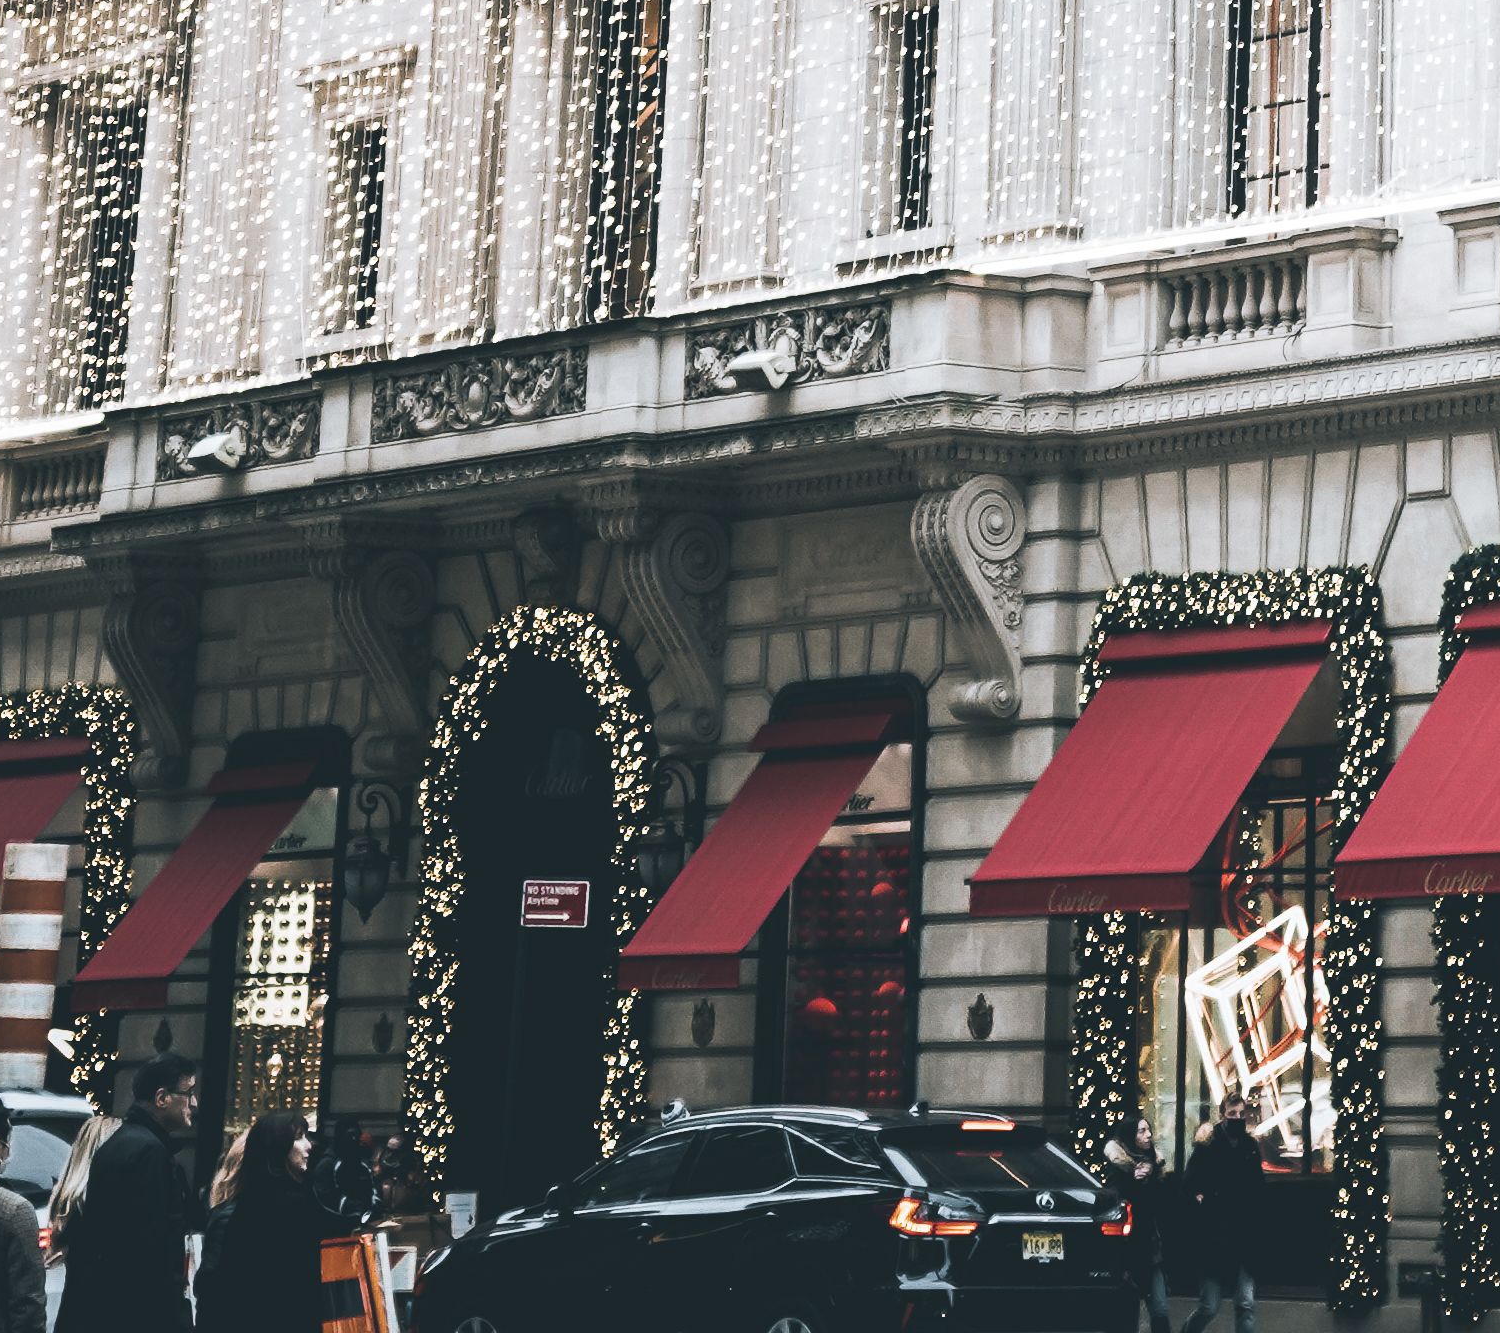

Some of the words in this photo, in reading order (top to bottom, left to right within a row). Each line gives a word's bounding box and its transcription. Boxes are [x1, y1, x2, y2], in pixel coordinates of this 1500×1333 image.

[1423, 860, 1494, 894] Cartier
[526, 885, 539, 895] NO
[540, 885, 580, 896] STANDING
[1047, 883, 1109, 912] Cartier
[526, 896, 560, 907] Anytime
